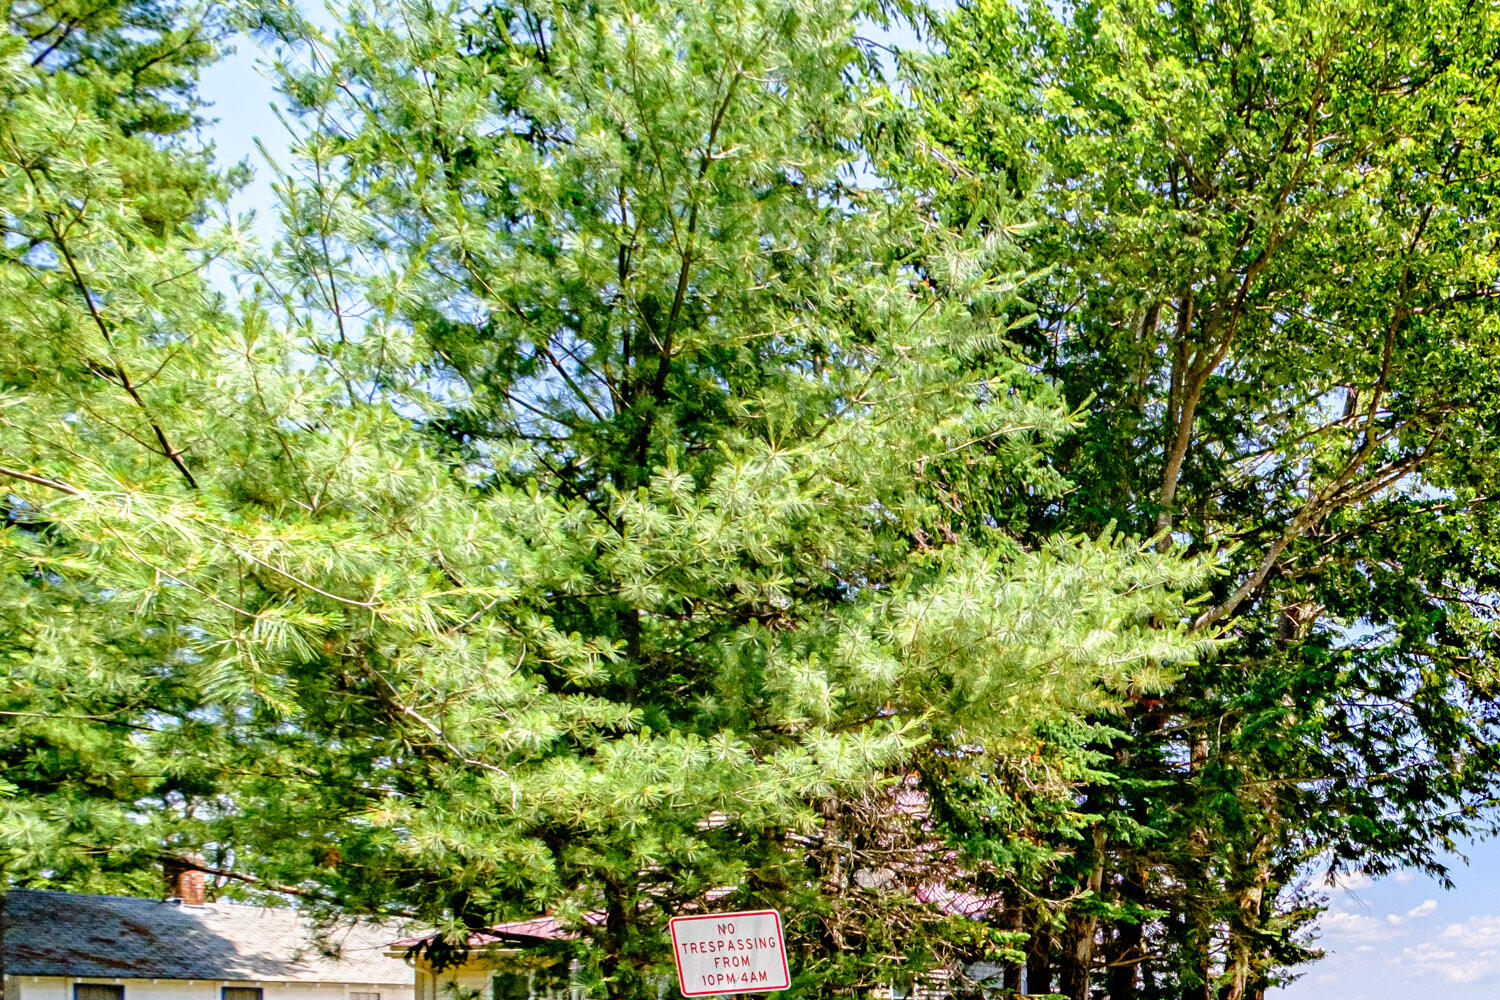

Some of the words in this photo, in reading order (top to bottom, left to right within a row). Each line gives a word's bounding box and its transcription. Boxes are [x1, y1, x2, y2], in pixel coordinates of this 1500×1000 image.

[717, 923, 735, 935] NO
[682, 936, 776, 954] TRESPASSING
[714, 955, 751, 968] FROM
